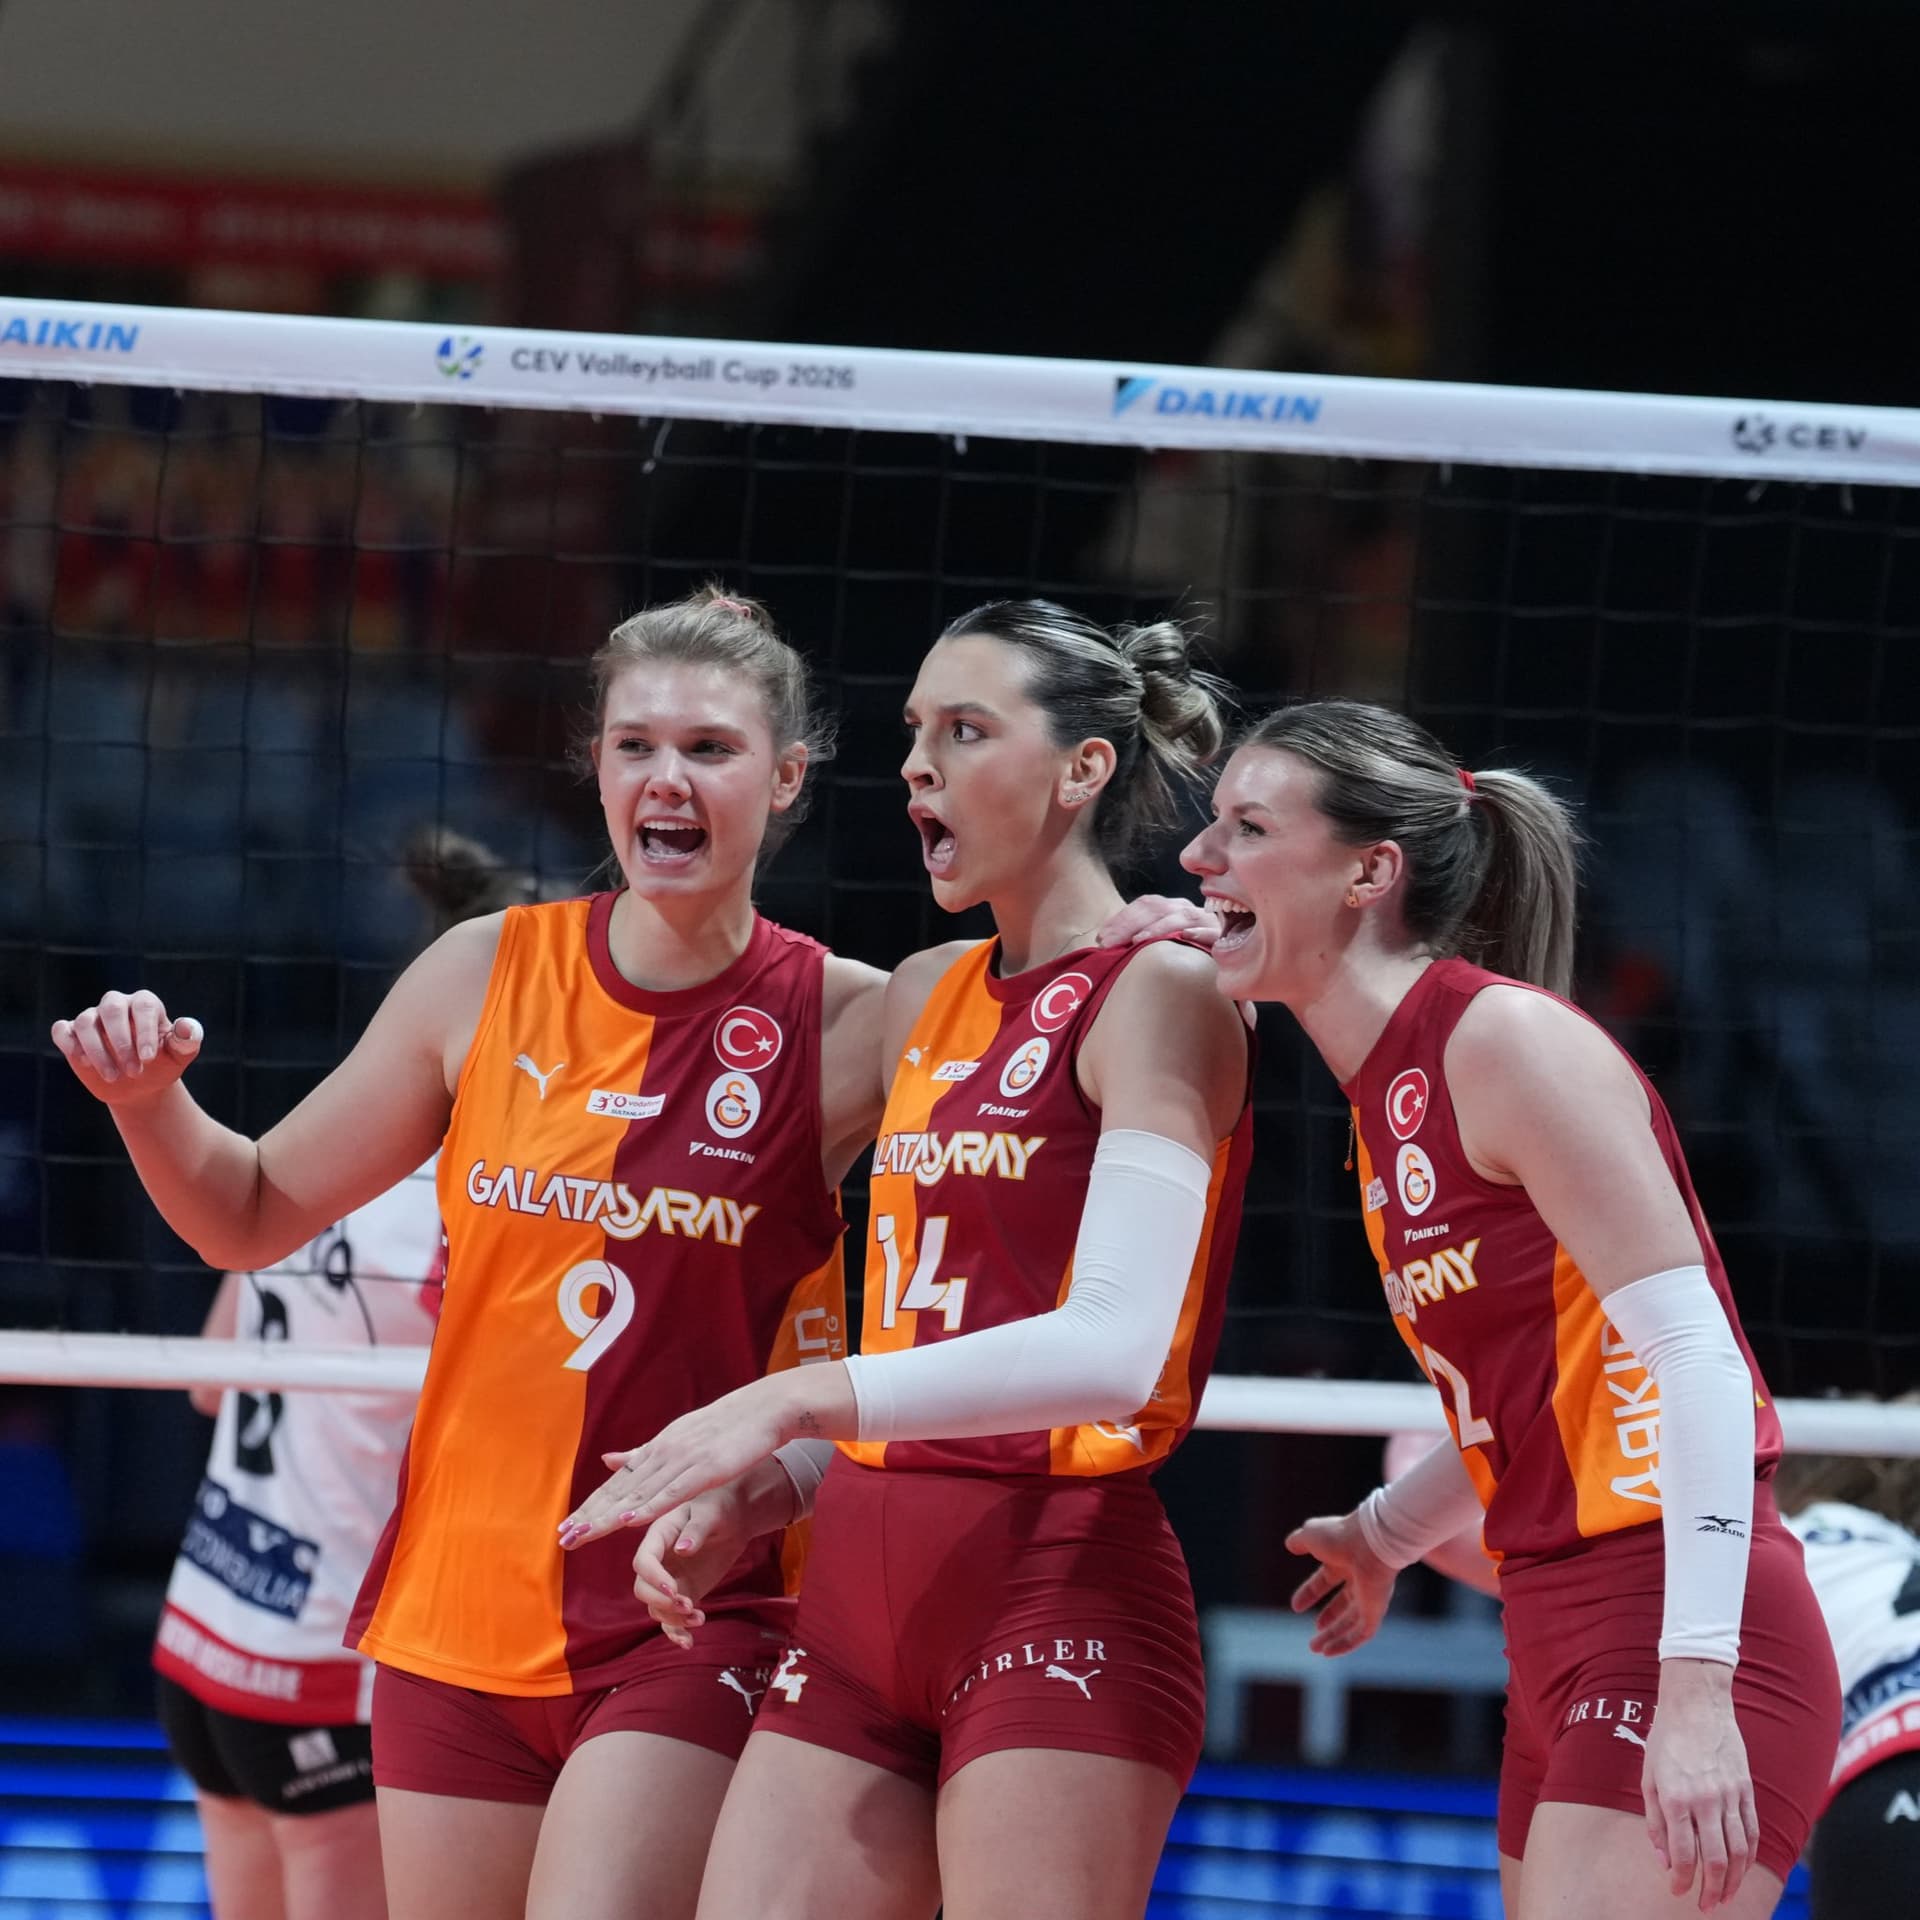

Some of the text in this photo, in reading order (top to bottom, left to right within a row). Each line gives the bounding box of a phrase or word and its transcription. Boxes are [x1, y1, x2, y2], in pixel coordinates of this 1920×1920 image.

[1, 317, 139, 352] AIKIN
[511, 348, 856, 391] CEV Volleyball Cup 2026
[1156, 387, 1323, 423] DAIKIN
[1786, 422, 1868, 450] CEV
[703, 1146, 756, 1164] DAIKIN
[872, 1131, 1048, 1187] LATASARAY
[467, 1159, 762, 1247] GALATASARAY
[1412, 1223, 1450, 1241] DAIKIN
[877, 1213, 968, 1331] 14
[557, 1258, 635, 1372] 9
[1410, 1342, 1496, 1450] 2
[941, 1639, 1107, 1717] İRLER
[1883, 1790, 1920, 1825] A
